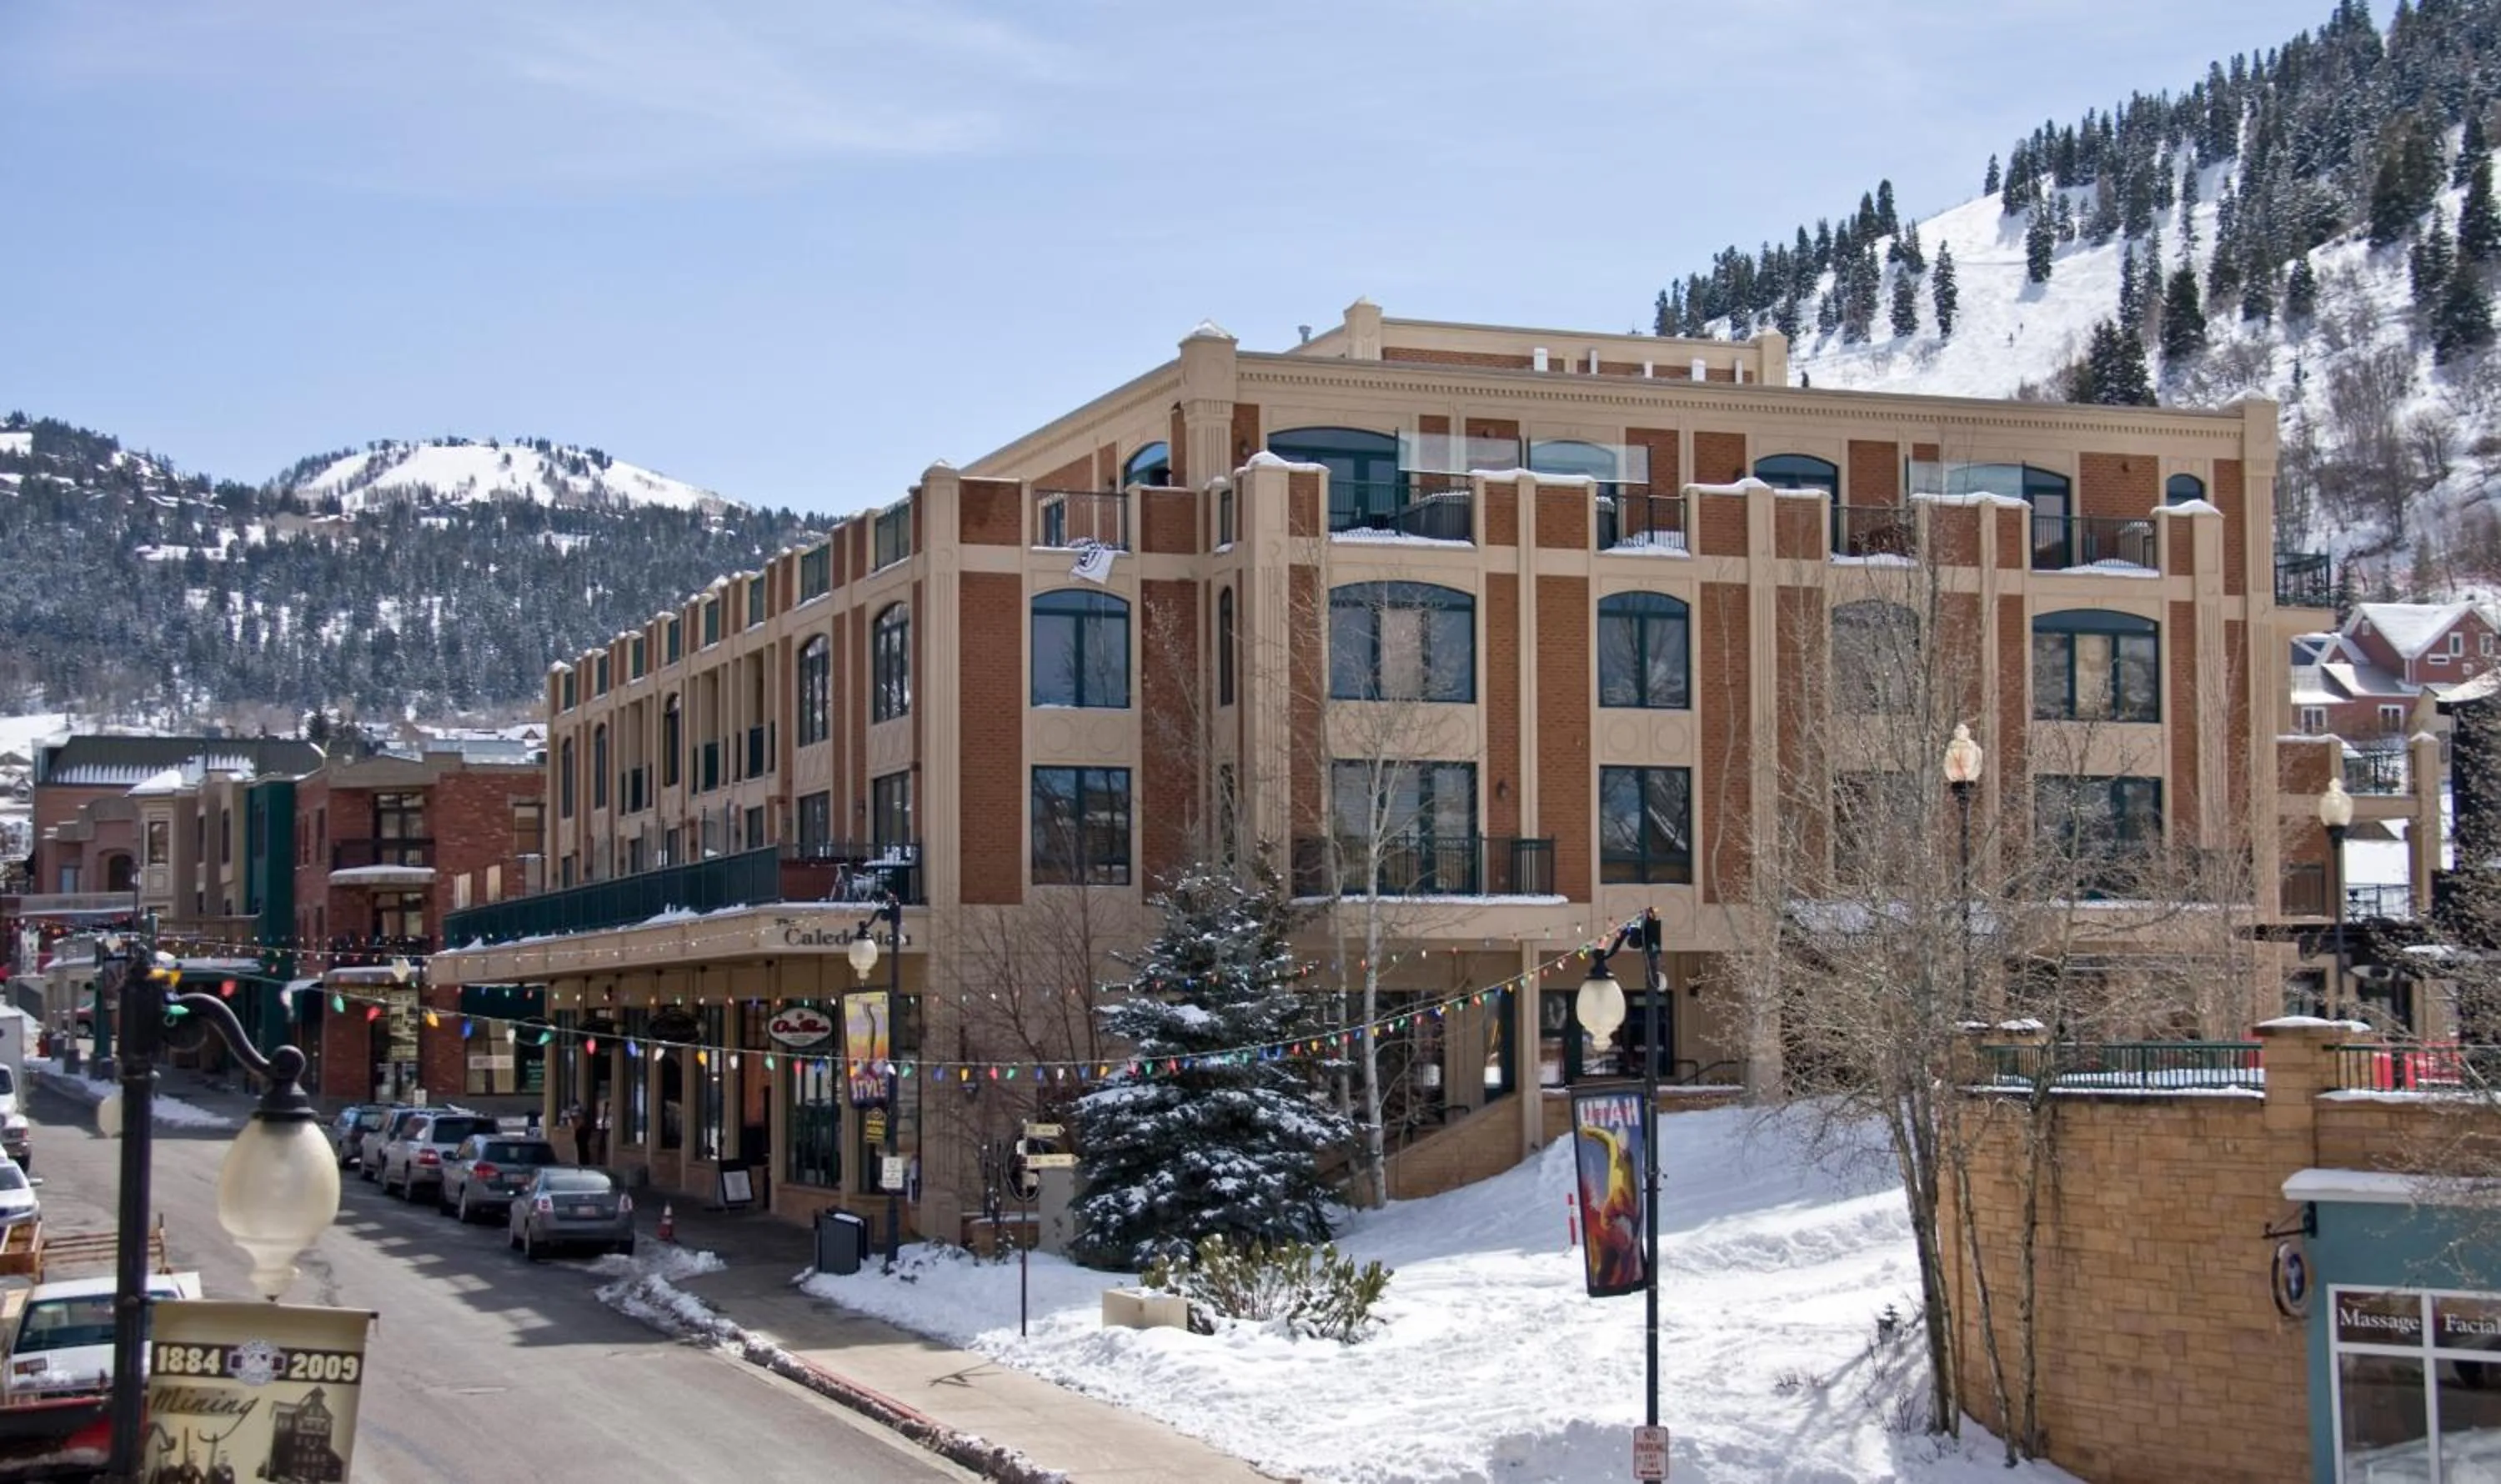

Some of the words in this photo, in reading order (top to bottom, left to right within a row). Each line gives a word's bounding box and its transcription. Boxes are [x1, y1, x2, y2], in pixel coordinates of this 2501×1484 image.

[1578, 1095, 1640, 1128] UTAH
[2339, 1307, 2421, 1334] Massage
[158, 1346, 221, 1375] 1884
[289, 1353, 359, 1381] 2009
[152, 1386, 260, 1442] Mining
[1644, 1431, 1658, 1441] NO
